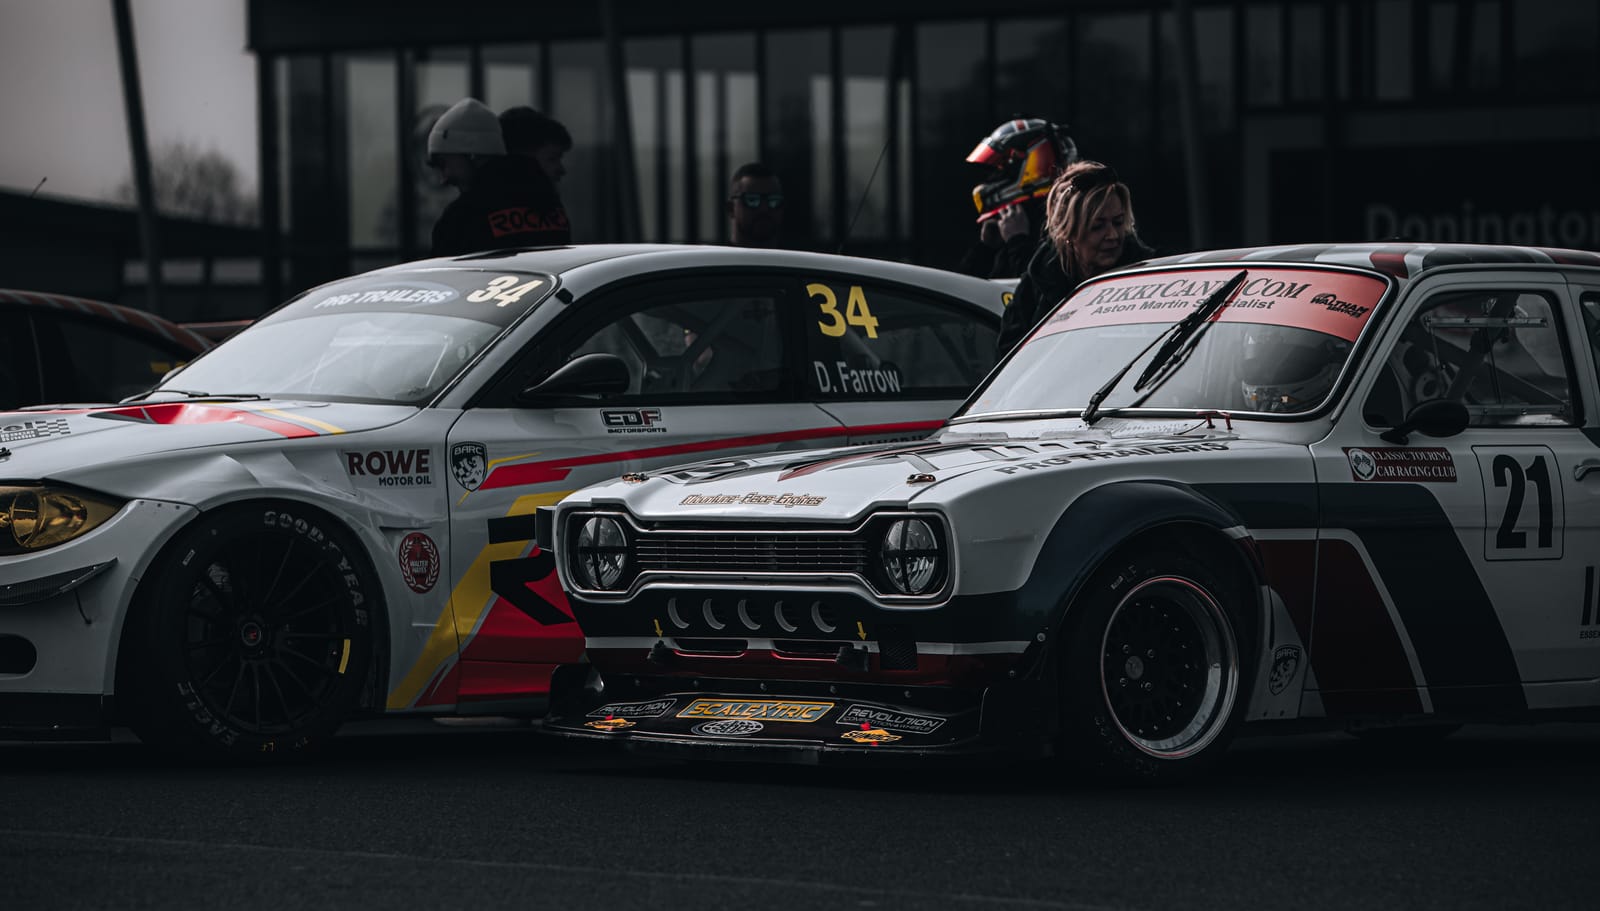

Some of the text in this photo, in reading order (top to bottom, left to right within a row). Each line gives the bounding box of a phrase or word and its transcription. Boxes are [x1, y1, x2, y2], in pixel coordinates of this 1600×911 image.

[354, 289, 453, 304] TRAILERS
[466, 275, 543, 308] 34
[805, 282, 879, 339] 34
[1090, 304, 1137, 315] Aston
[1139, 299, 1189, 310] Martin
[1310, 295, 1369, 313] WALTHAM
[813, 360, 901, 393] D. Farrow
[602, 410, 659, 426] EDF
[454, 445, 483, 455] BARC
[994, 441, 1230, 475] PRG TRAILERS
[1371, 451, 1451, 462] CLASSIC TOURING
[345, 449, 430, 476] ROWE
[1376, 465, 1456, 478] CAR RACING CLUB
[378, 475, 432, 486] MOTOR OIL
[1491, 454, 1553, 549] 21
[1275, 648, 1299, 659] BARC
[598, 701, 670, 714] REVOLUTION
[687, 701, 822, 720] SCALEXTRIC
[848, 708, 939, 727] REVOLUTION
